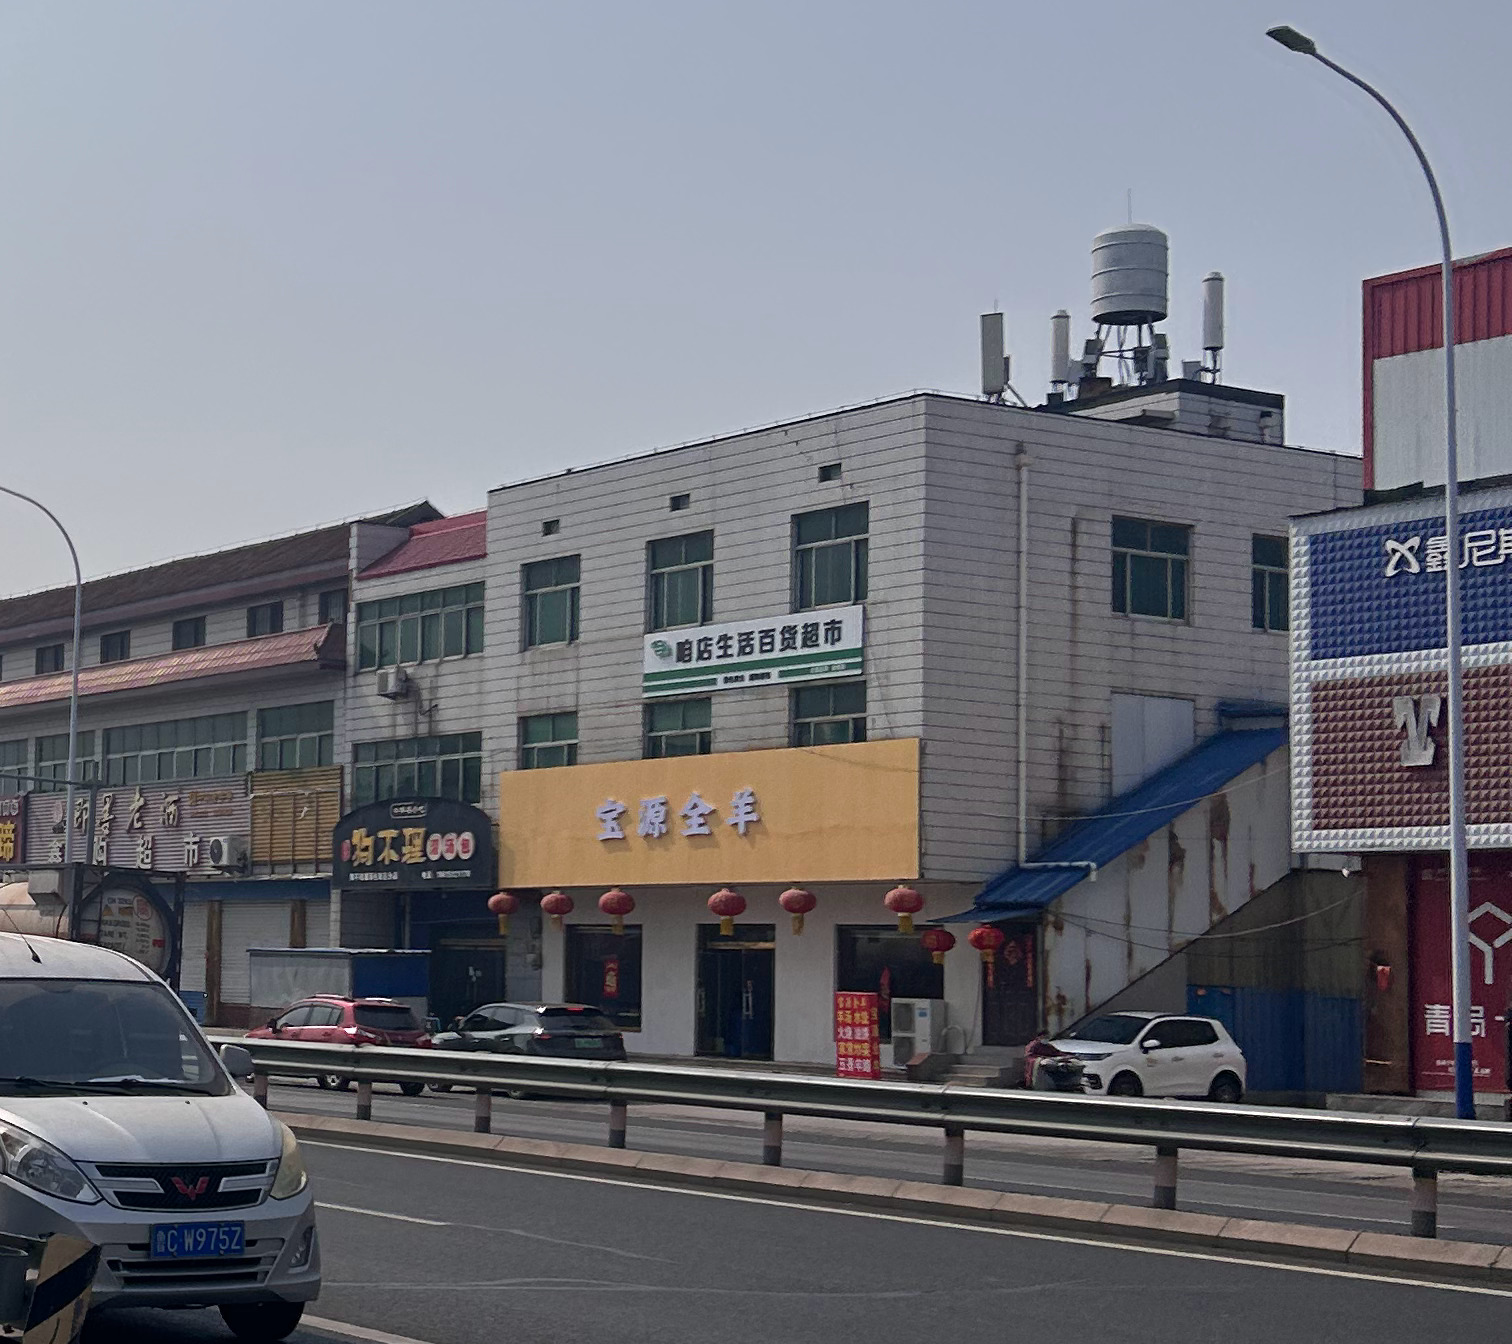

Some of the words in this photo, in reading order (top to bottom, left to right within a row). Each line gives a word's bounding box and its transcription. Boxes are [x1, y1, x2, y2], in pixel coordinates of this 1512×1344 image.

[674, 618, 843, 664] 咱店生活百货超市
[595, 786, 761, 841] 宝源全羊
